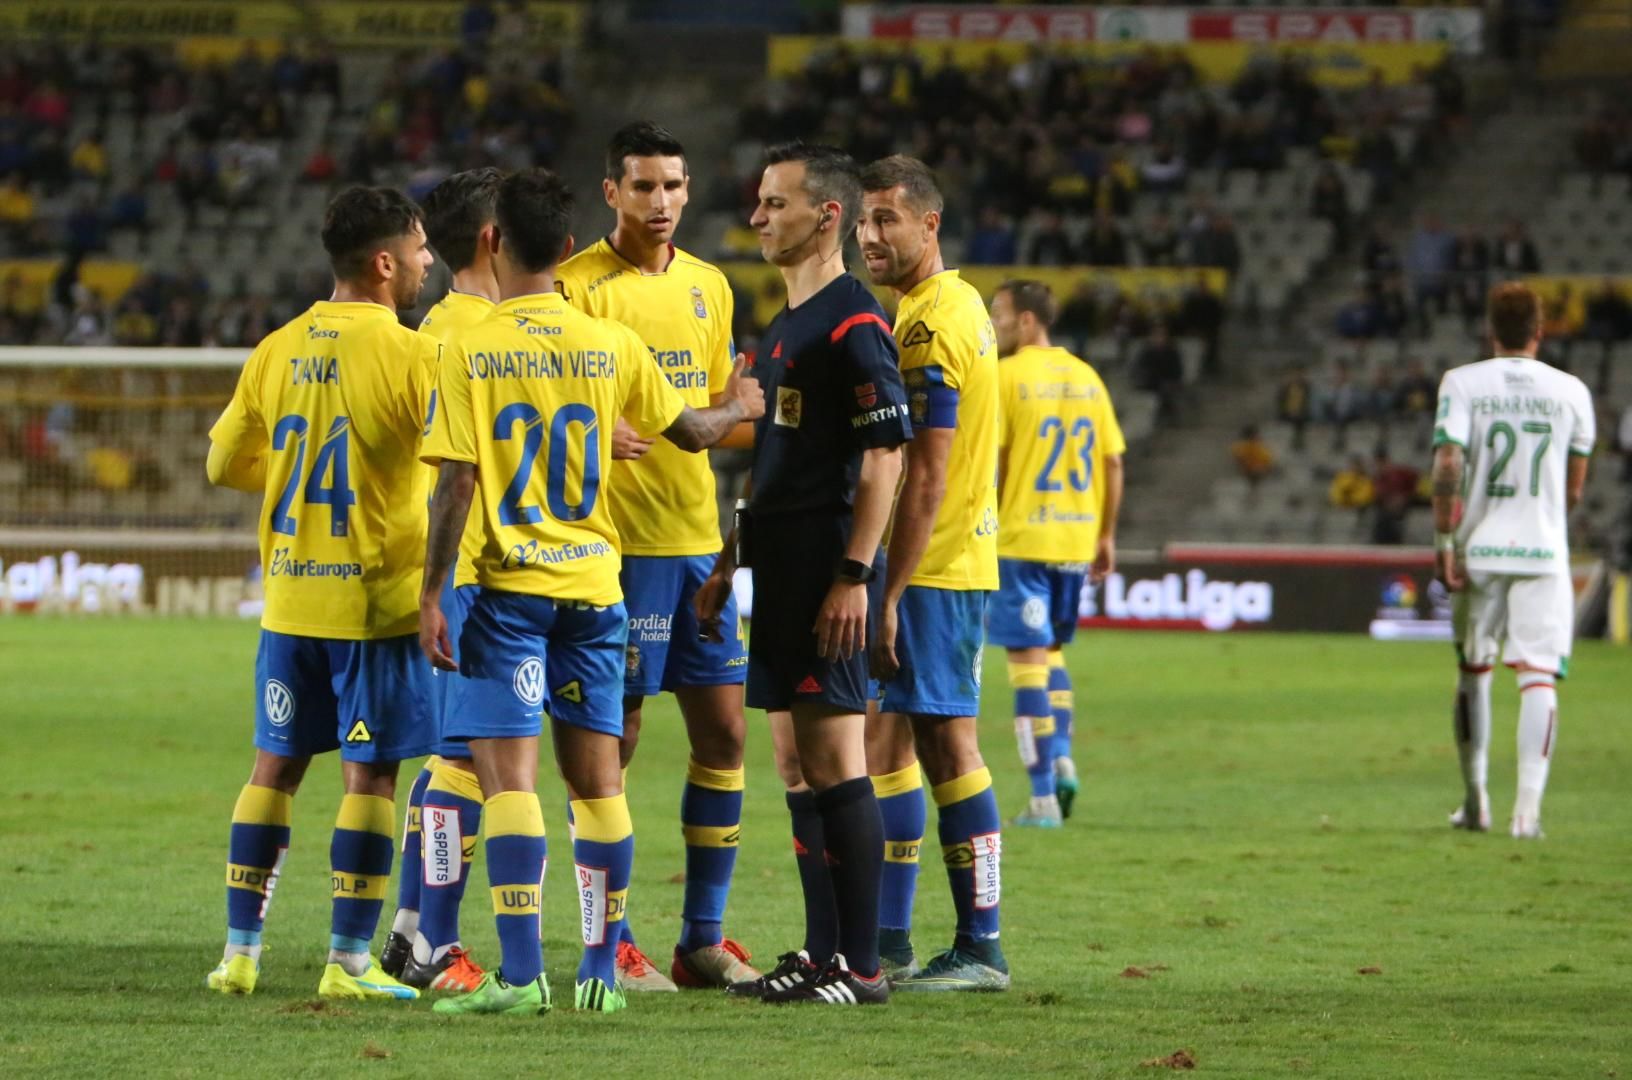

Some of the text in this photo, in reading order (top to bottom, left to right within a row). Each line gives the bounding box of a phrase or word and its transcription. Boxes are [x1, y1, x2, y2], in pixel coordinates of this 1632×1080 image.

[911, 11, 1092, 42] SPAR
[1231, 12, 1408, 43] SPAR
[290, 356, 339, 385] TANA
[468, 351, 615, 380] JONATHAN VIERA
[493, 402, 600, 526] 20
[1034, 415, 1095, 492] 23
[1486, 420, 1553, 497] 27
[271, 414, 356, 537] 24
[283, 559, 362, 580] AirEuropa
[541, 541, 610, 563] AirEuropa
[0, 551, 144, 611] aLiga
[1104, 568, 1273, 630] LaLiga
[640, 630, 672, 641] hotels
[434, 831, 449, 882] SPORTS
[986, 854, 996, 903] SPORTS
[502, 891, 539, 908] UDL
